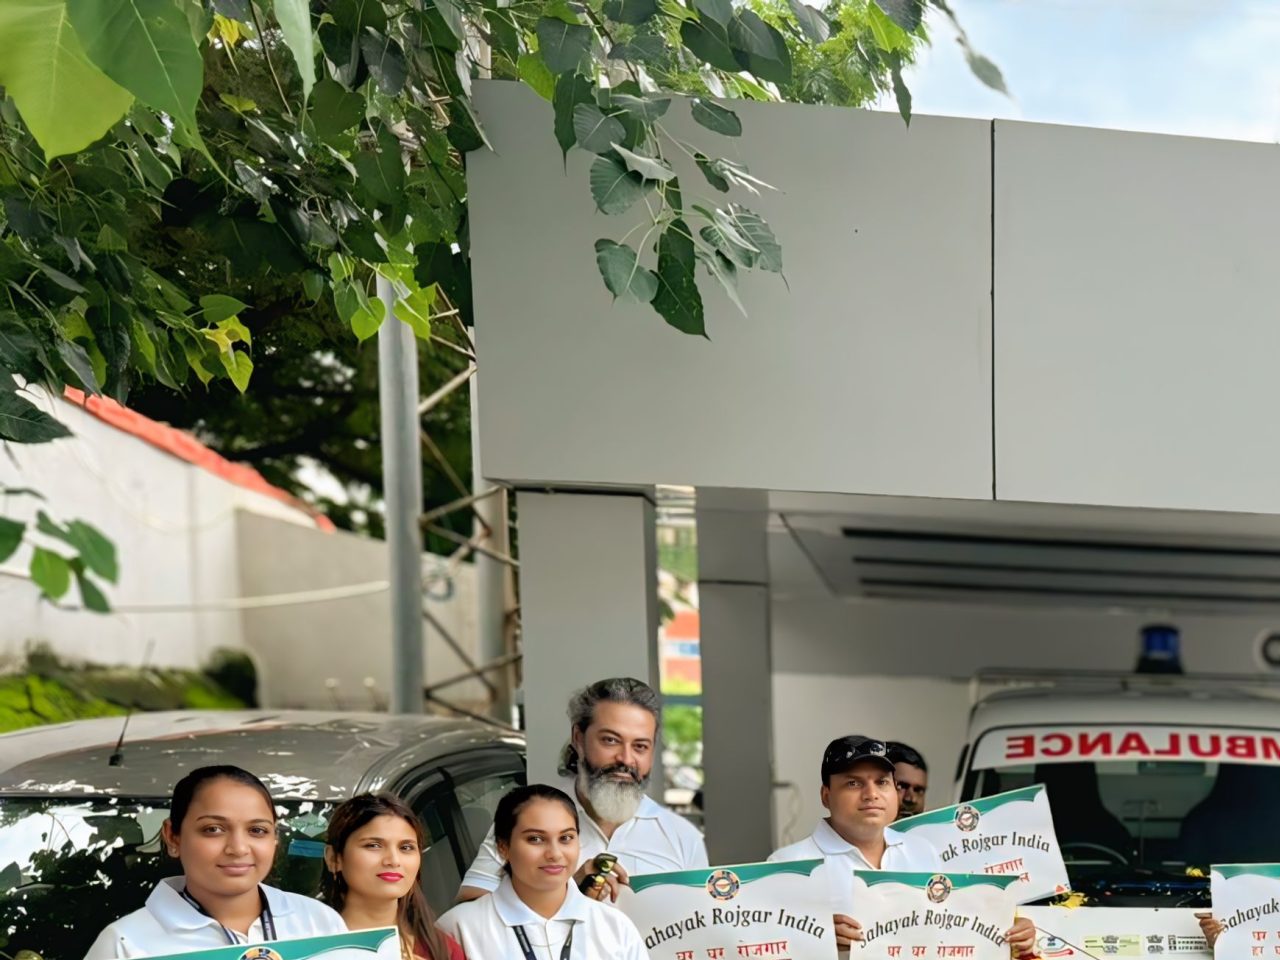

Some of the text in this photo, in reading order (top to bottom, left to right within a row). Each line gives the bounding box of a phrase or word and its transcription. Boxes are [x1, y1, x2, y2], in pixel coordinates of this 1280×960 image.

[962, 833, 1008, 853] Rojgar
[1012, 831, 1050, 852] India
[645, 905, 826, 949] ahayak Rojgar India
[924, 909, 969, 929] Rojgar
[971, 916, 1006, 947] India
[706, 948, 725, 960] घर
